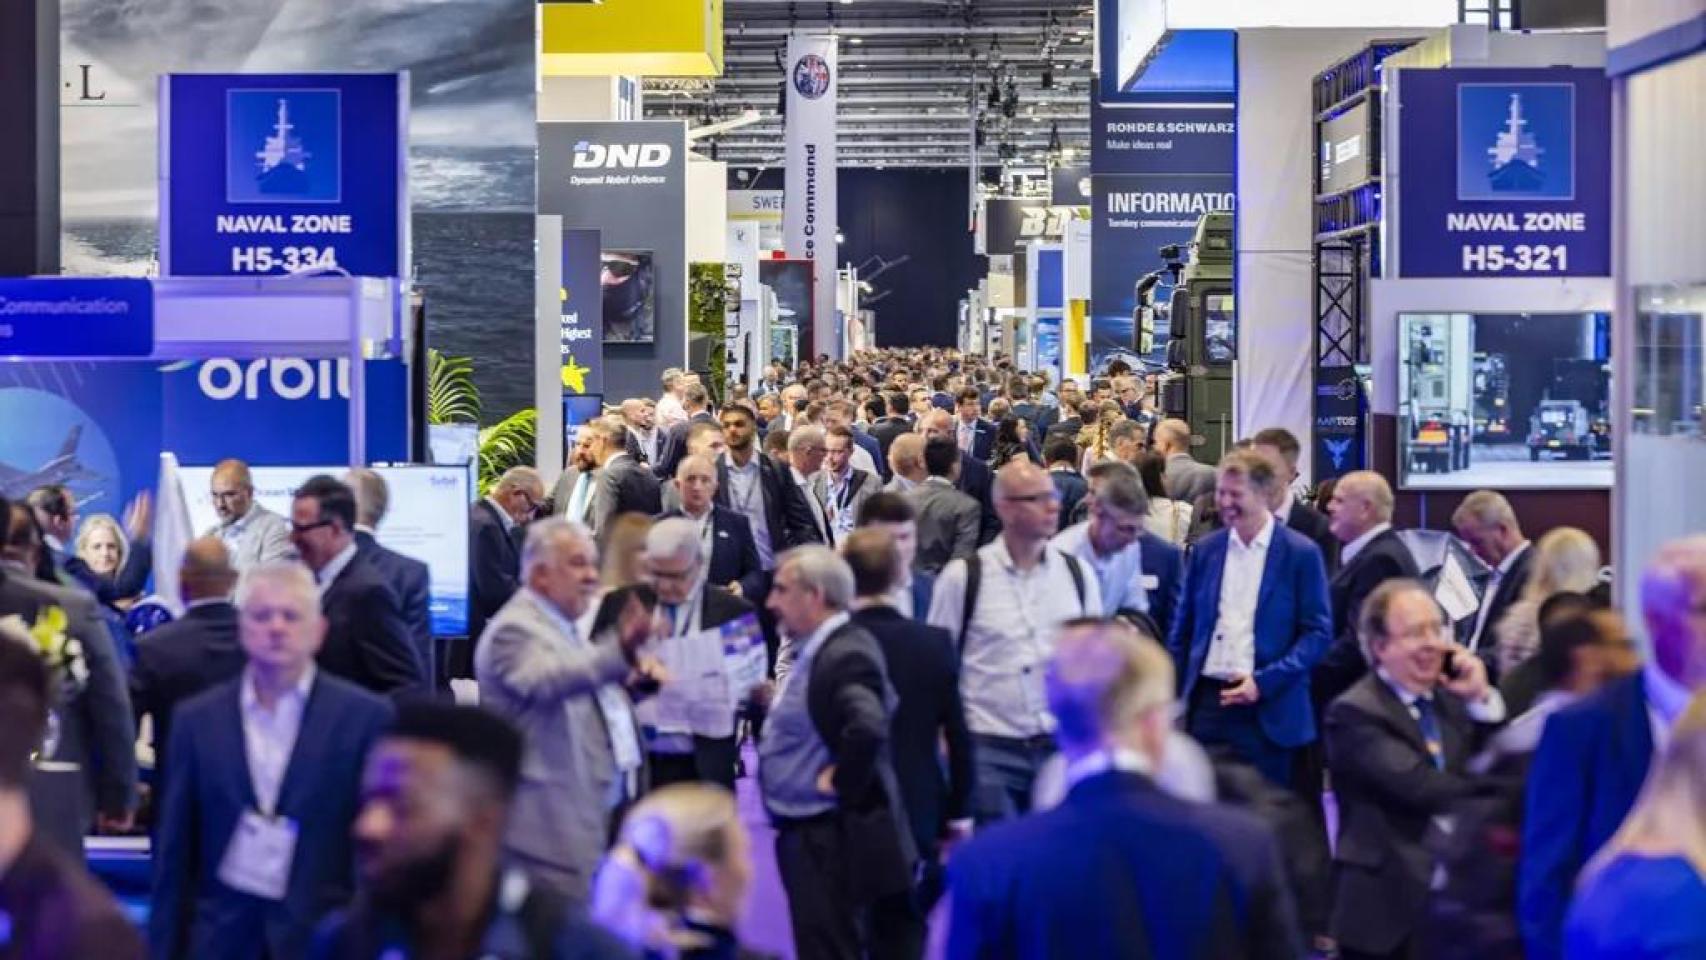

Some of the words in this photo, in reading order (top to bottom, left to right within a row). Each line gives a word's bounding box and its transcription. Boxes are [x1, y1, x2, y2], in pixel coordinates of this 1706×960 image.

[1107, 122, 1235, 133] ROHDE&SCHWARZ
[573, 141, 672, 168] DND
[804, 144, 816, 236] Command
[216, 214, 288, 233] NAVAL
[291, 214, 352, 233] ZONE
[1447, 213, 1520, 231] NAVAL
[1523, 213, 1586, 231] ZONE
[231, 246, 338, 272] H5-334
[1462, 245, 1568, 271] H5-321
